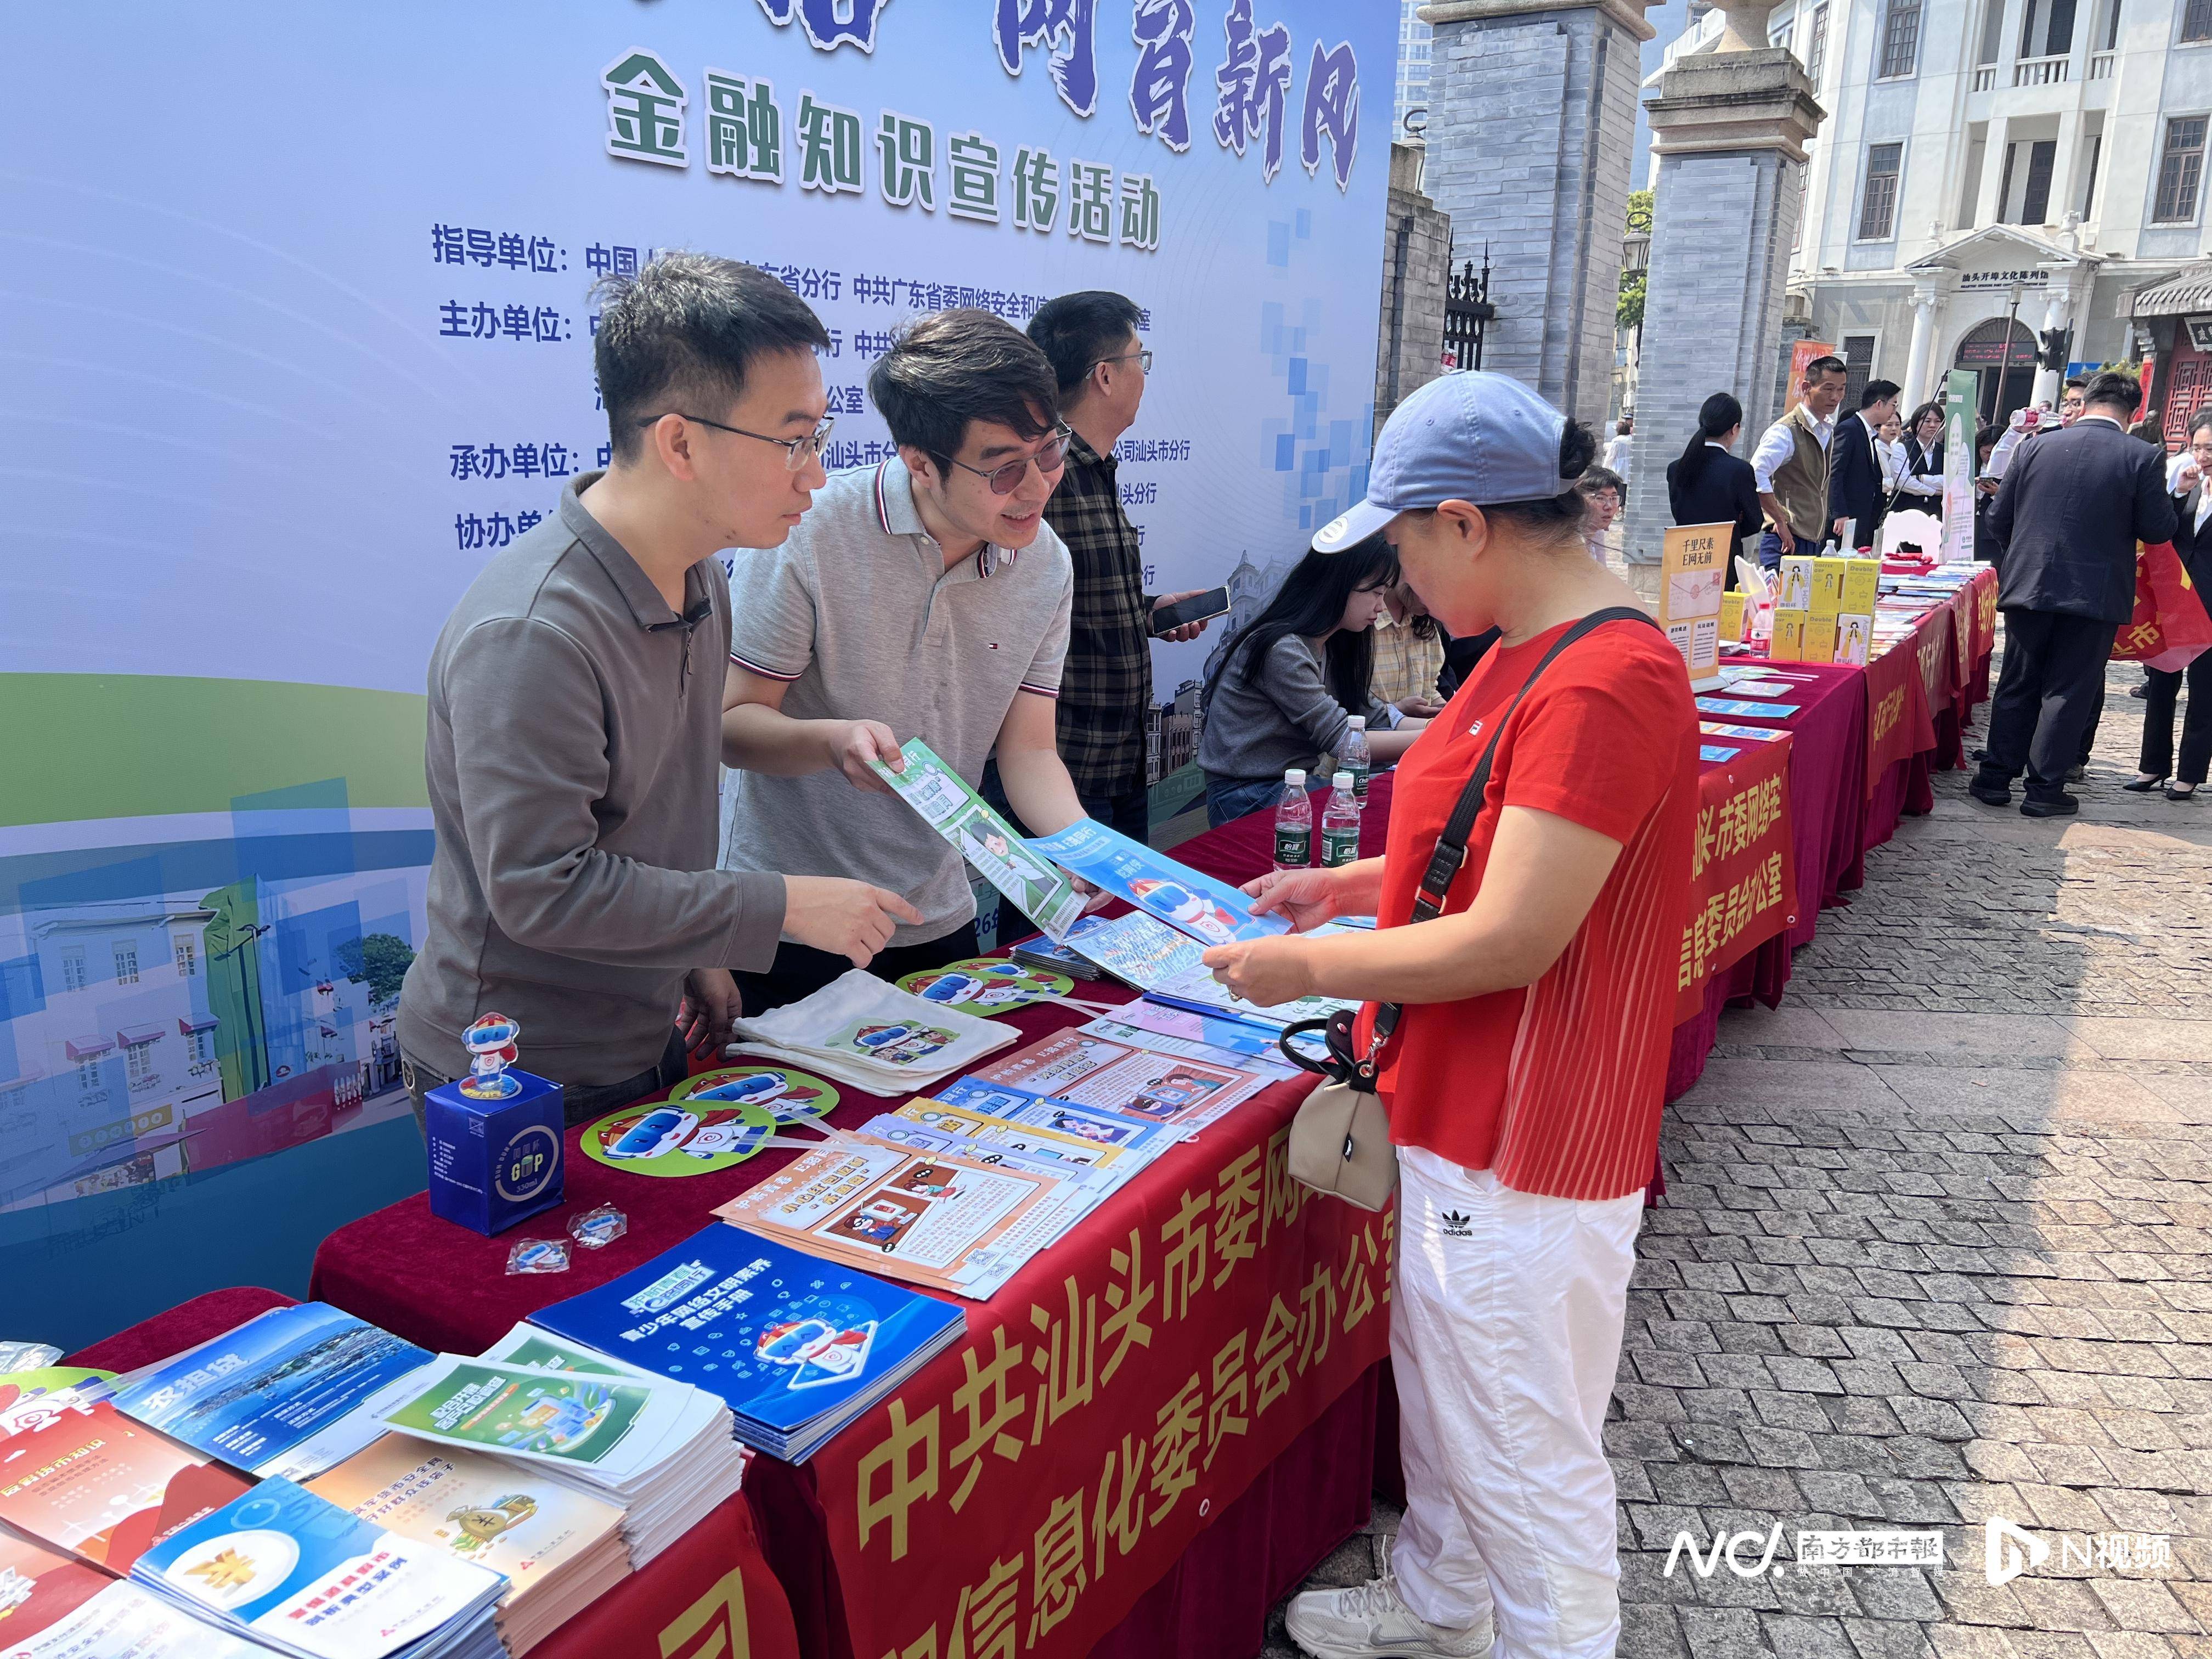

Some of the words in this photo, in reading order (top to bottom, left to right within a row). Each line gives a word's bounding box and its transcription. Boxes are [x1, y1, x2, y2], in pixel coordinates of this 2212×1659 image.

[602, 49, 1161, 248] 金融知识宣传活动
[1962, 269, 2049, 283] 汕头开埠文化陈列馆
[454, 512, 552, 550] 协办单
[1682, 537, 1714, 552] 千里尺素
[1682, 552, 1713, 566] E网无前
[619, 1258, 772, 1342] 青少年网络文明素养
[629, 1266, 691, 1307] 护航青春
[679, 1288, 754, 1331] 宣传手册
[856, 1122, 1325, 1561] 中共汕头市委网
[878, 1210, 1393, 1659] 信息化委员会办公
